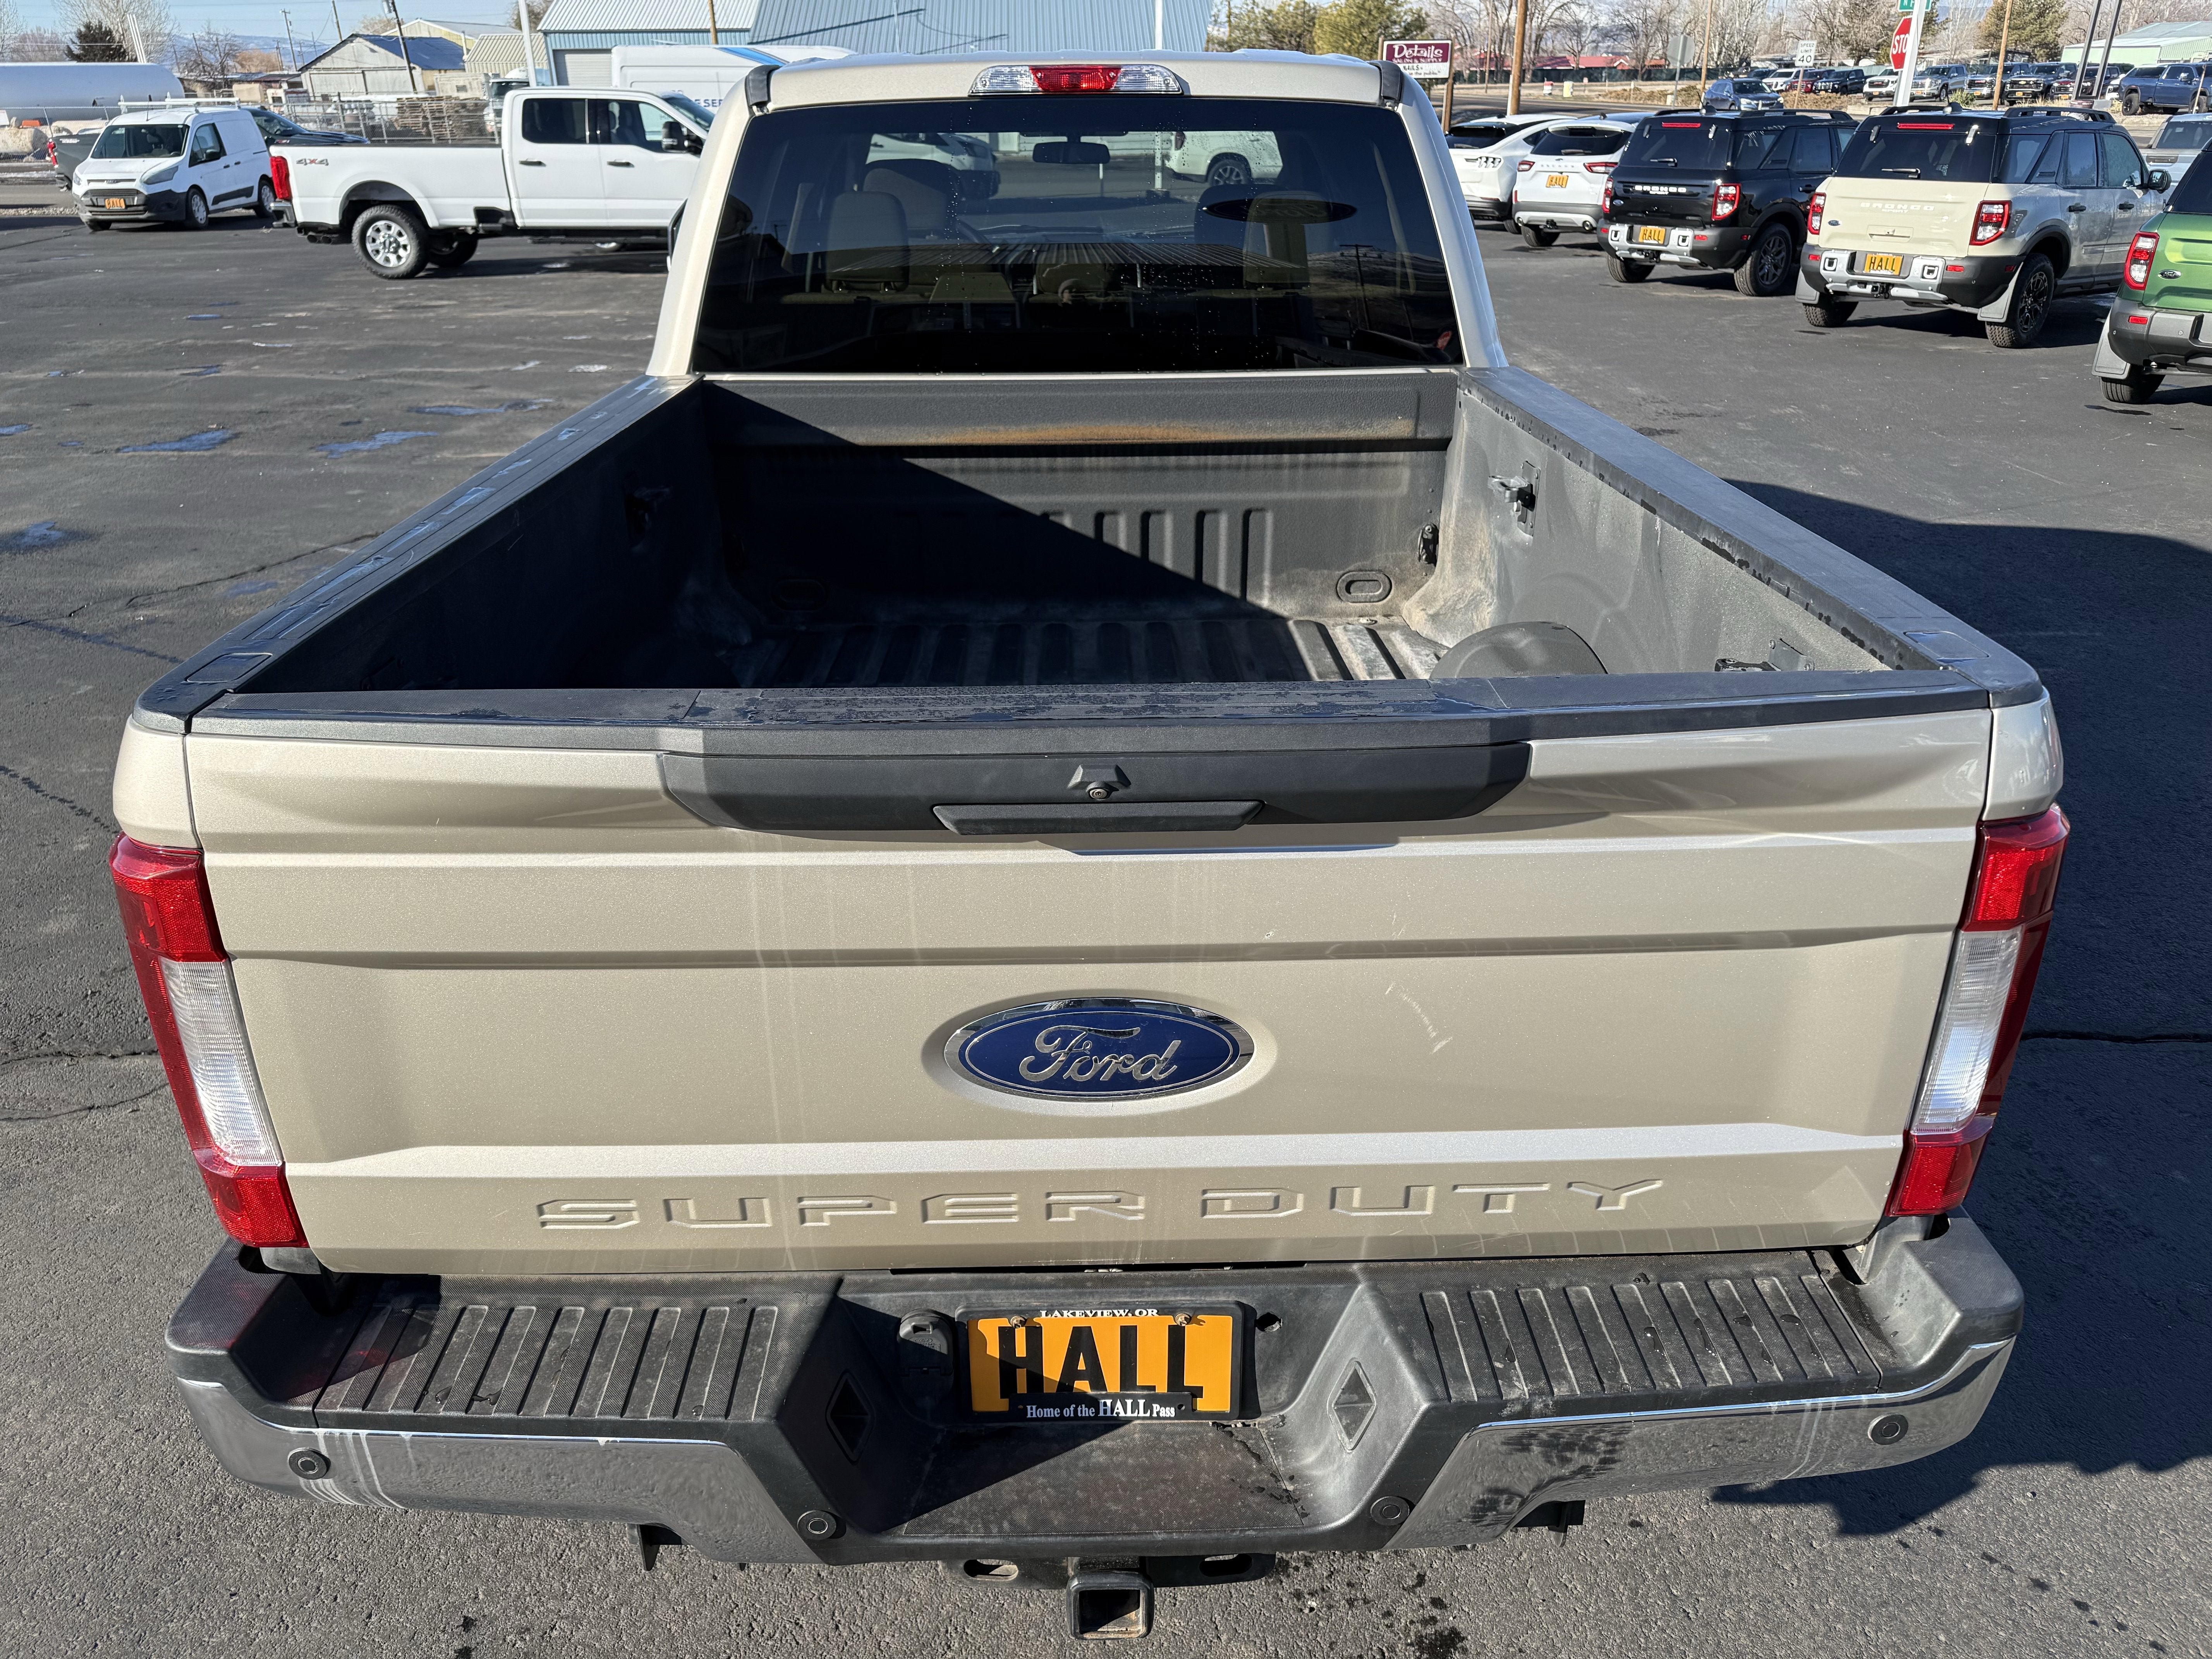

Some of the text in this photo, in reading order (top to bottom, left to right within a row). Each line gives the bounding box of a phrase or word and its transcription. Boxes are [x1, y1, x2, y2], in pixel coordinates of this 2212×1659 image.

[1393, 44, 1443, 58] Details
[1893, 34, 1909, 55] STO
[1860, 202, 1935, 211] BRONCO
[1642, 229, 1661, 241] HALL
[1869, 256, 1896, 271] HALL
[1019, 1024, 1182, 1082] Ford
[537, 1179, 1664, 1230] SUPER DUTY
[998, 1324, 1204, 1399] HALL
[1026, 1398, 1175, 1418] Home of the HALL Pass
